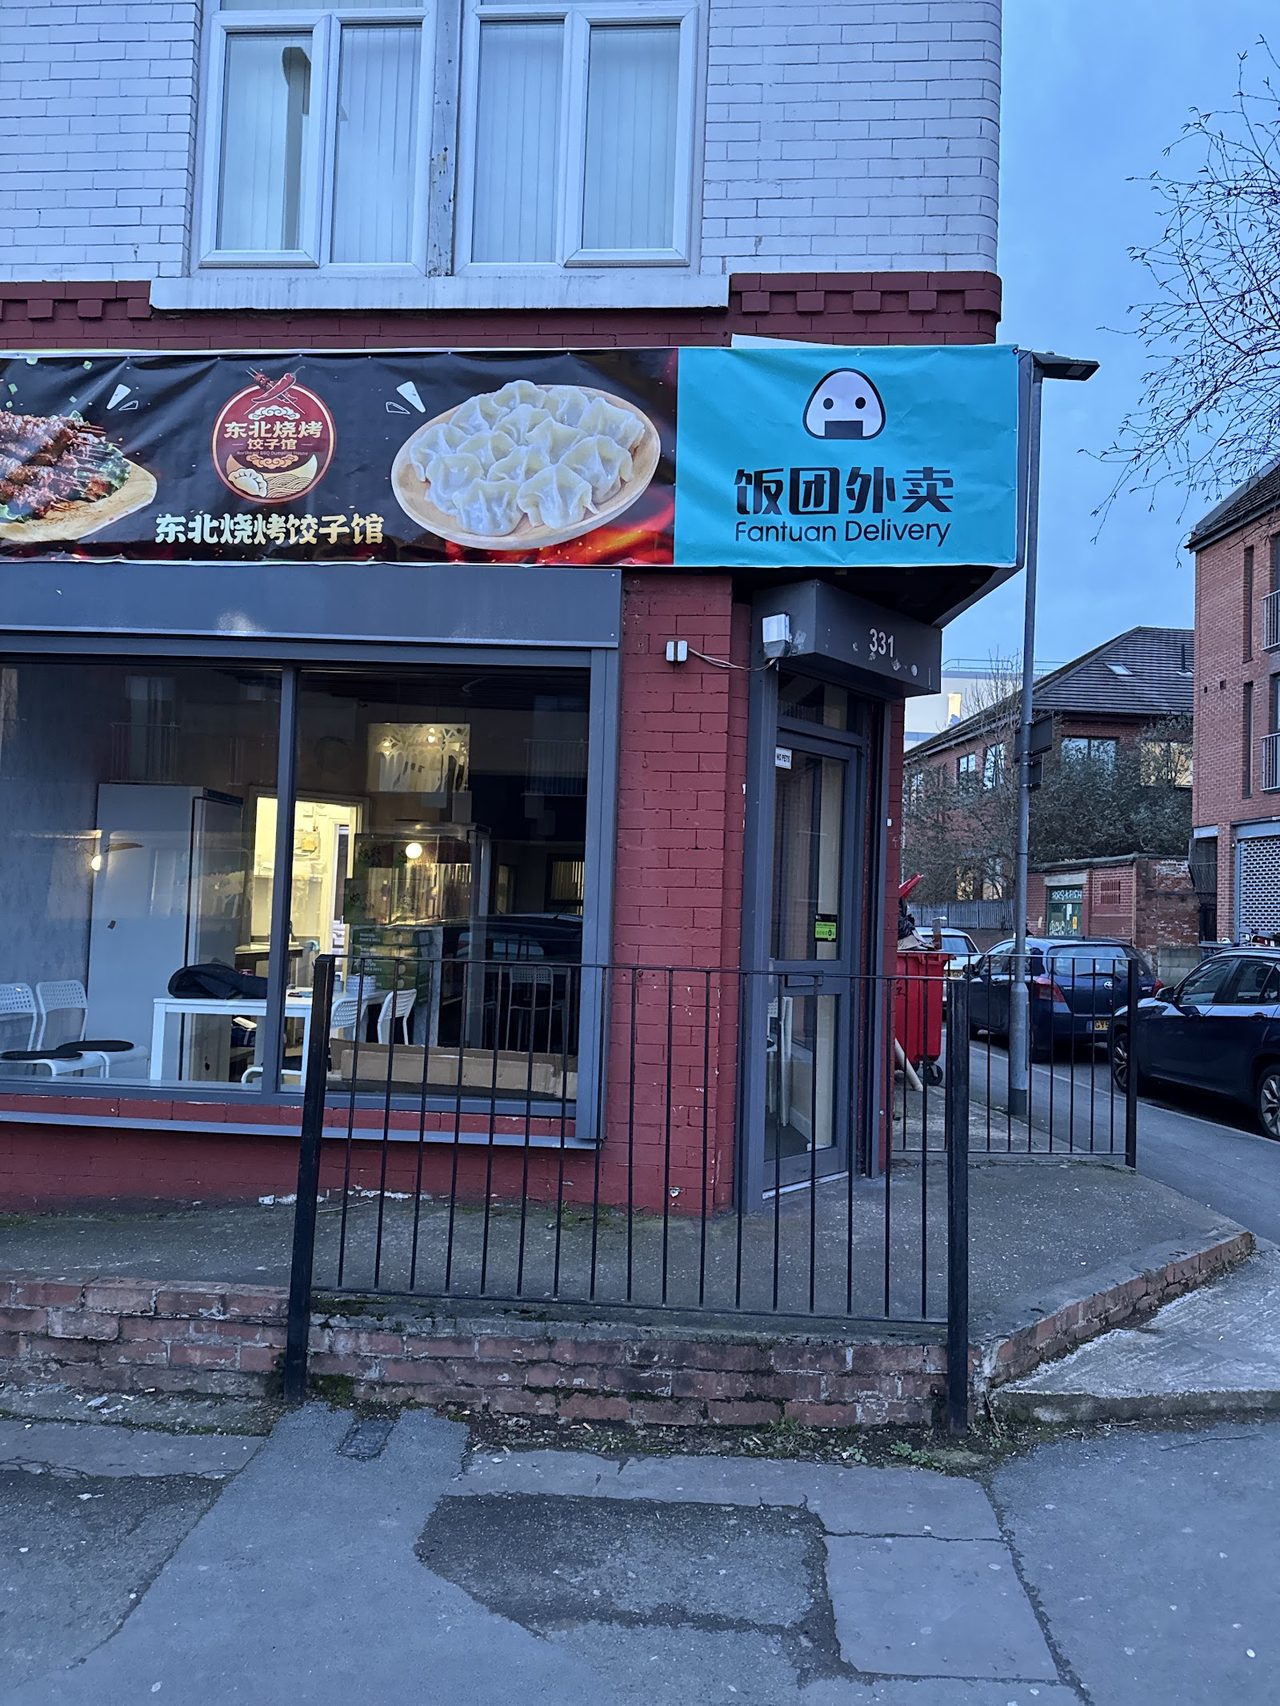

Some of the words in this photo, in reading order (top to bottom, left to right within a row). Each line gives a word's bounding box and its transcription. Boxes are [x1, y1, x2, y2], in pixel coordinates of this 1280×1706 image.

[224, 421, 323, 439] 东北烧烤
[247, 438, 298, 450] 饺子馆
[734, 466, 954, 516] 饭团外卖
[155, 513, 385, 545] 东北烧烤饺子馆
[735, 521, 836, 542] Fantuan
[845, 519, 952, 547] Delivery
[869, 628, 894, 658] 331
